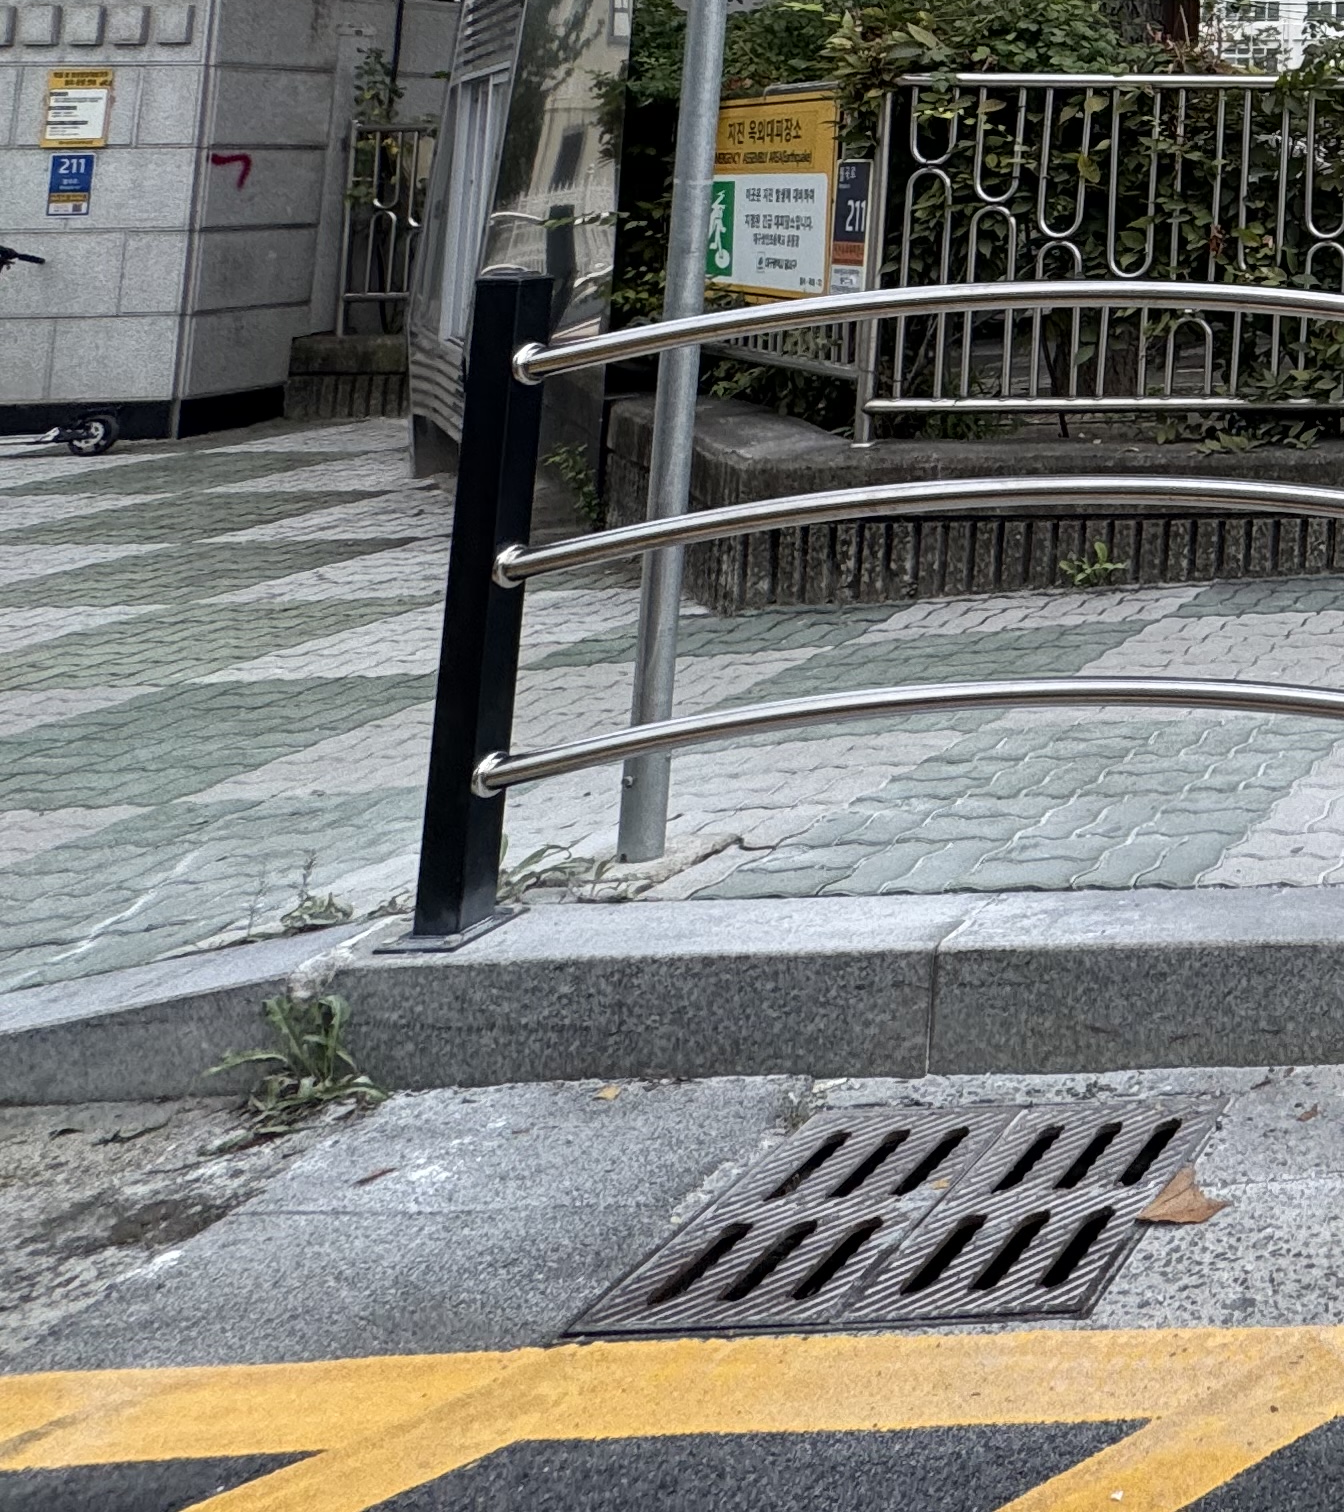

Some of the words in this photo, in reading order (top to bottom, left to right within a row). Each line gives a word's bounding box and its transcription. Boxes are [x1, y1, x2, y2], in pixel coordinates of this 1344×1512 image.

[727, 120, 745, 145] 지진
[748, 117, 802, 143] 옥외대피장소
[58, 158, 86, 174] 211
[845, 199, 866, 232] 211
